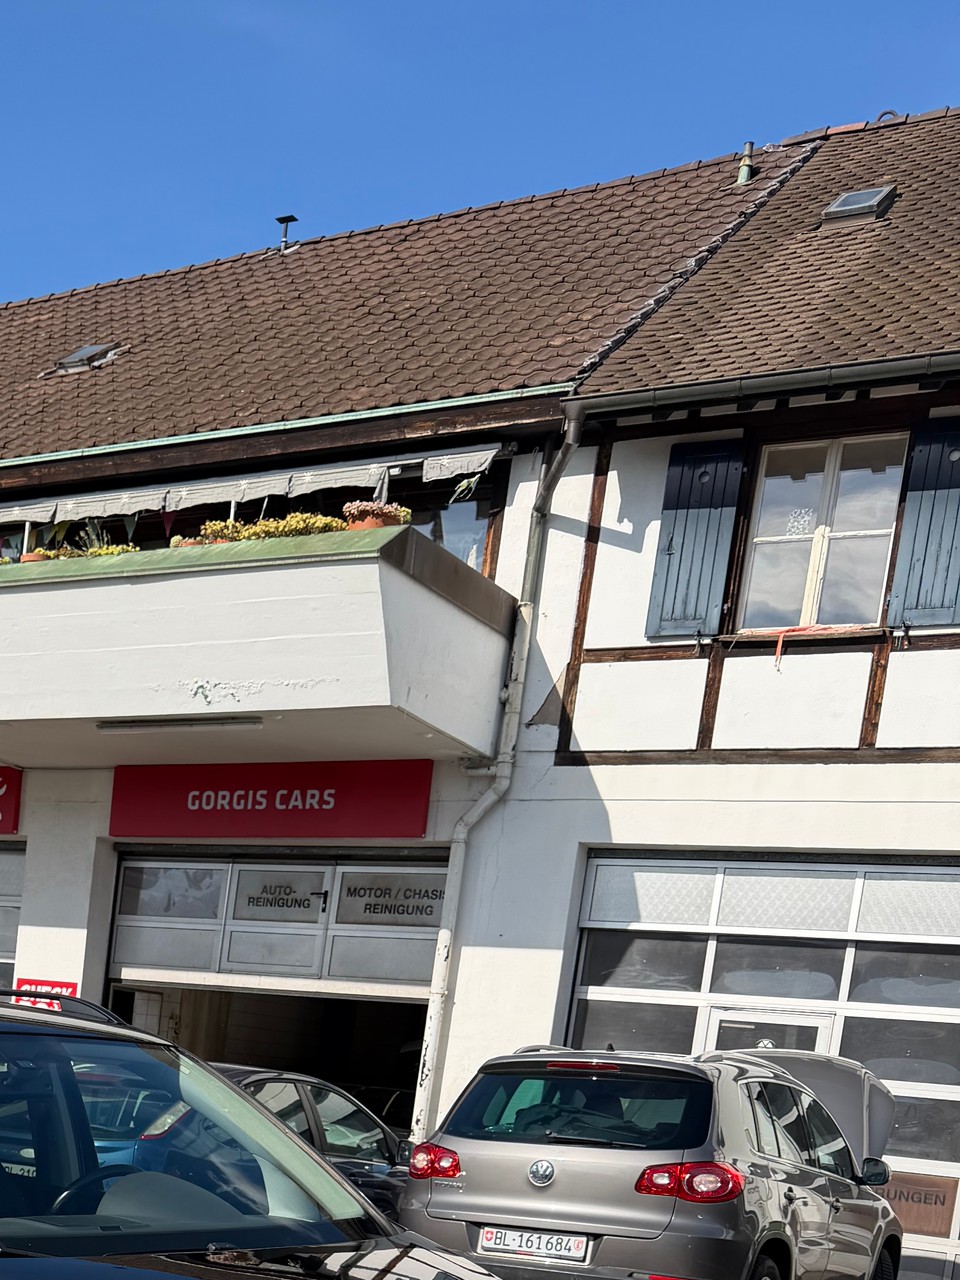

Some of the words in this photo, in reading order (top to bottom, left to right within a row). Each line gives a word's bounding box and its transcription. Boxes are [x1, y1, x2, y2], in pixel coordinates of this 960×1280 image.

[187, 790, 268, 810] GORGIS
[275, 789, 335, 810] CARS
[260, 884, 297, 896] AUTO-
[346, 887, 392, 899] MOTOR
[247, 896, 311, 909] REINIGUNG
[363, 903, 434, 916] REINIGUNG
[872, 1186, 946, 1206] RUNGEN
